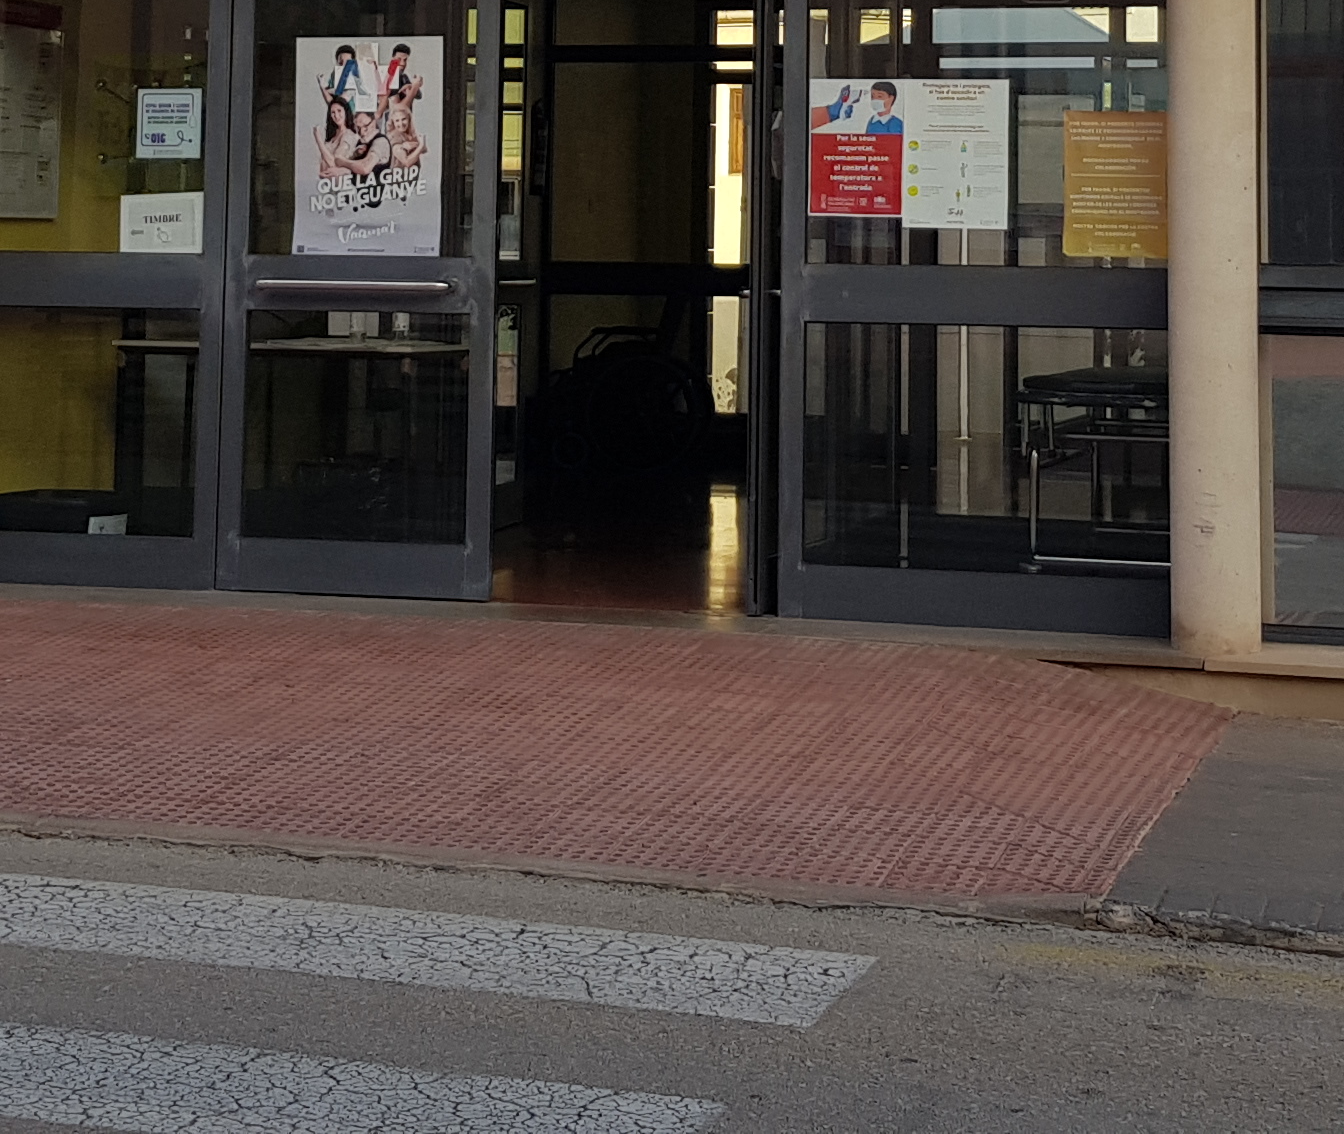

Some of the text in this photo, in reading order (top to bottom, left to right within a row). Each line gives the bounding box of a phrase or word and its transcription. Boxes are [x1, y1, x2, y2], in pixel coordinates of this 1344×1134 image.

[317, 165, 419, 194] QUE LA GRIP
[310, 192, 335, 212] NO
[356, 179, 427, 203] GUANYE
